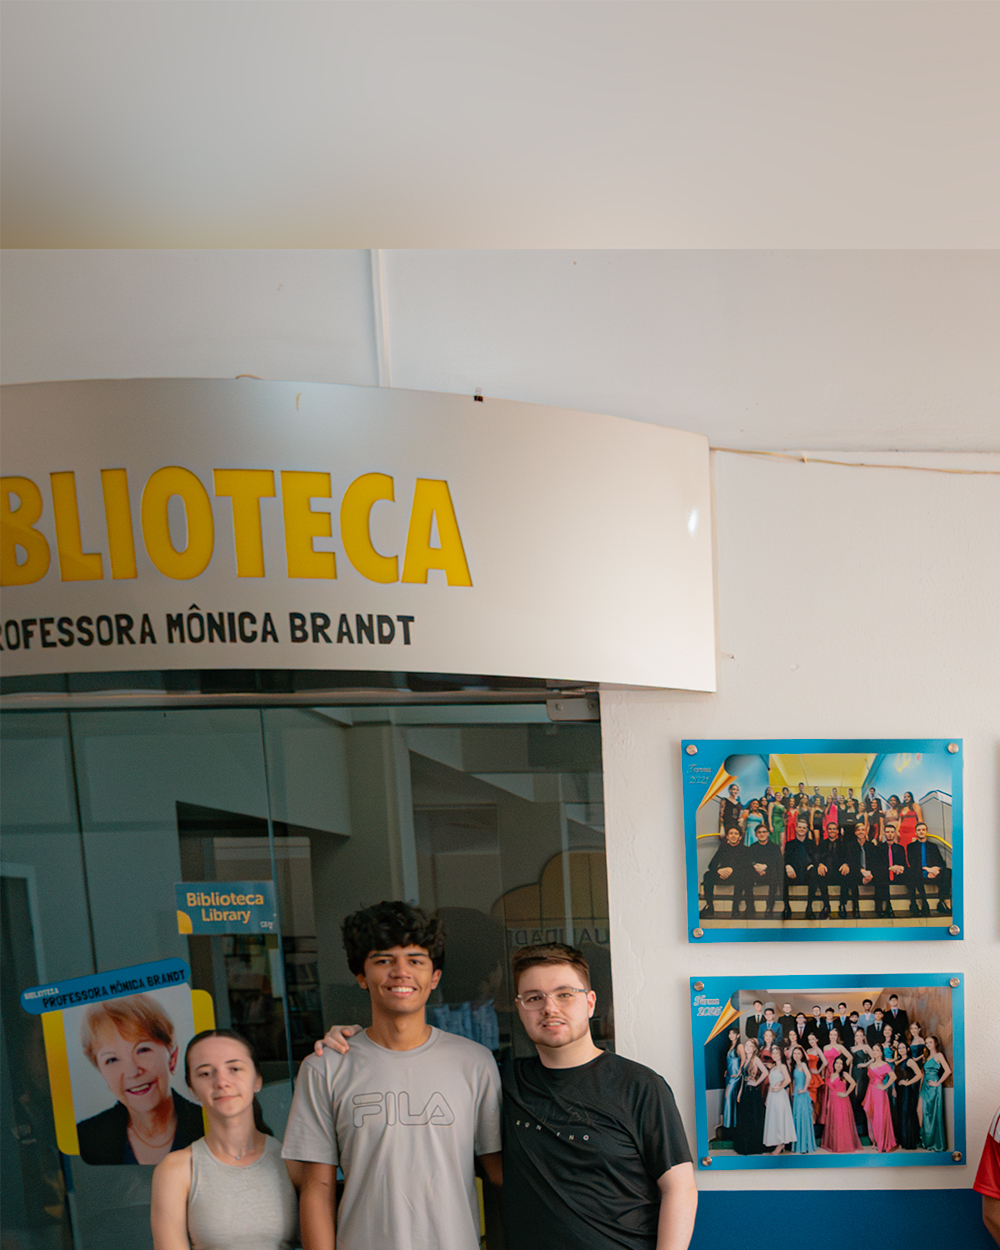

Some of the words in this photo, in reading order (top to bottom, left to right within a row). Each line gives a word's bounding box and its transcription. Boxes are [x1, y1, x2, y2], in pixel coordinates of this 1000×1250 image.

[0, 466, 474, 587] BLIOTECA
[166, 604, 279, 644] MÔNICA
[289, 612, 415, 645] BRANDT
[186, 892, 264, 907] Biblioteca
[201, 908, 251, 924] Library
[42, 985, 109, 1009] PROFESSORA
[146, 969, 186, 987] BRANDT
[352, 1090, 456, 1129] FILA
